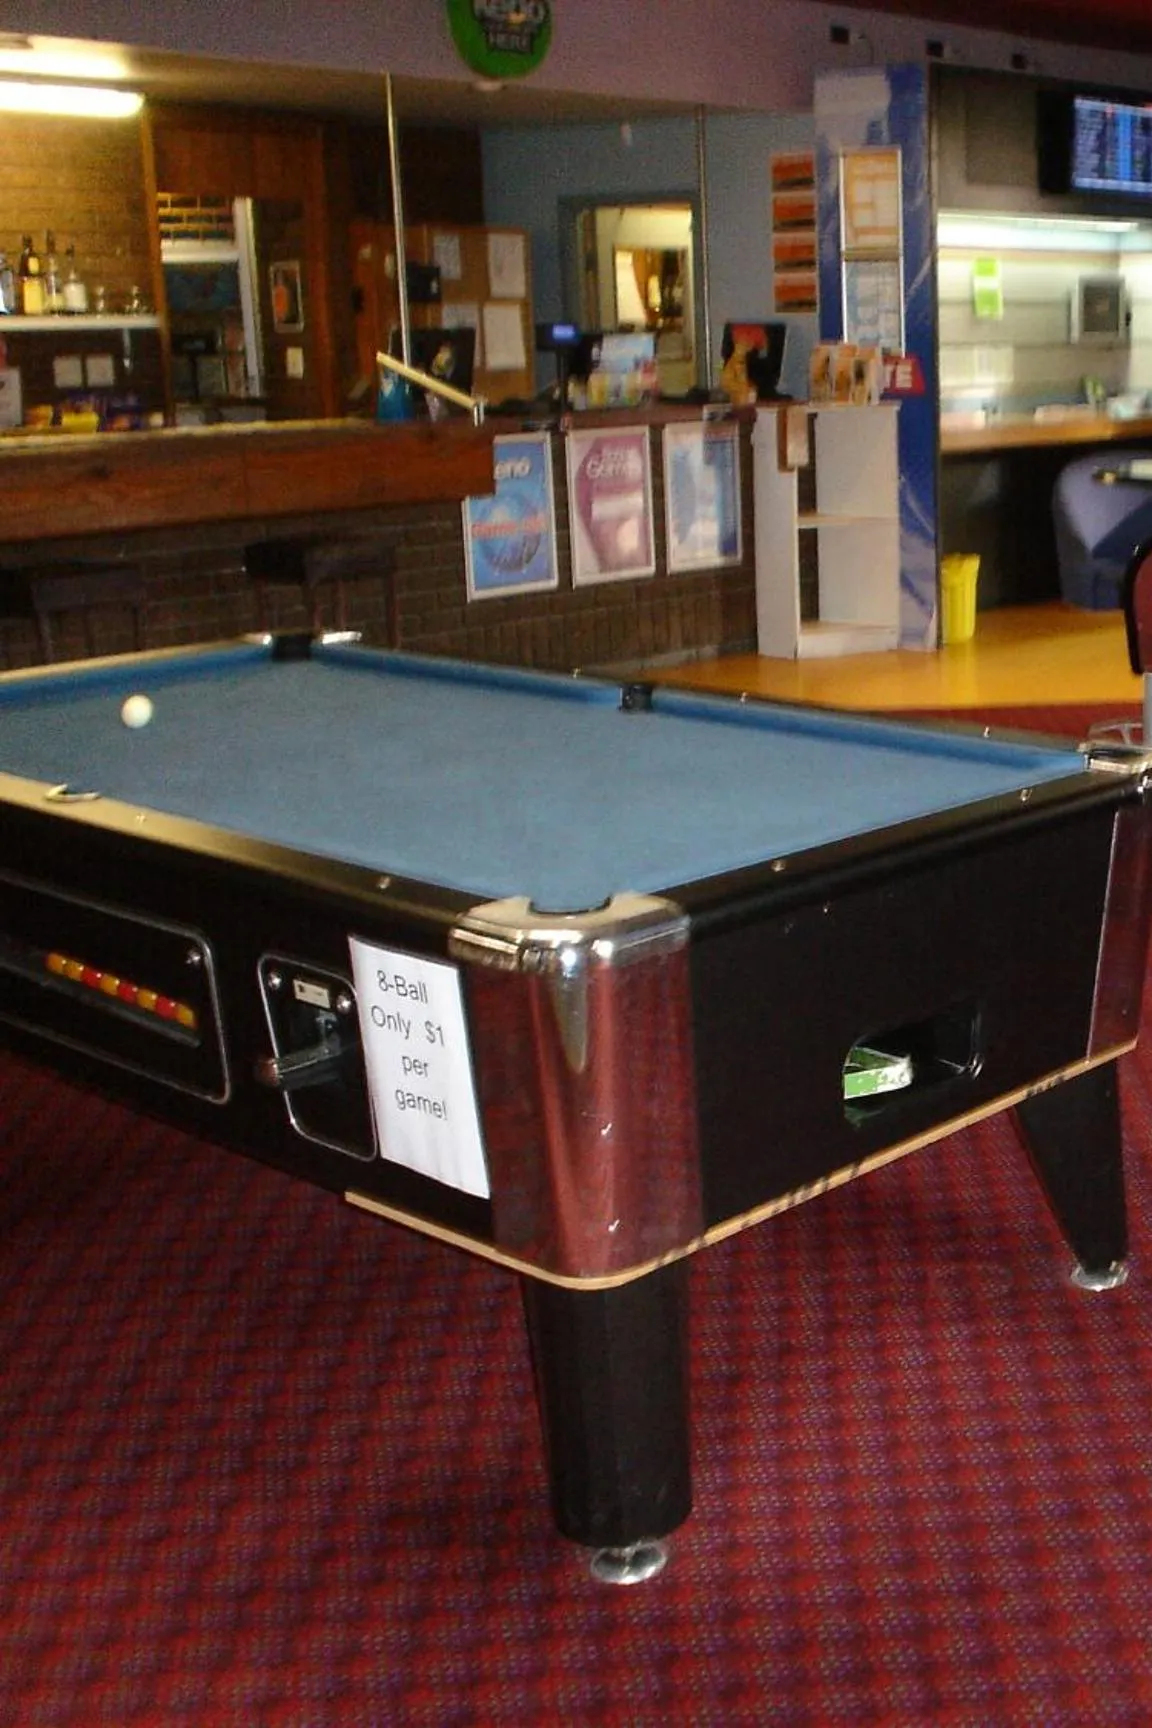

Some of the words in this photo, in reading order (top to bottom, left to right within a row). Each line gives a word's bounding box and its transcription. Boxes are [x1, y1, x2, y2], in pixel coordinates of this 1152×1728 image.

[493, 456, 531, 481] eno
[377, 969, 428, 1004] 8-Ball
[371, 1005, 412, 1040] Only
[425, 1020, 445, 1047] $1
[402, 1055, 428, 1078] per
[395, 1088, 448, 1121] game!
